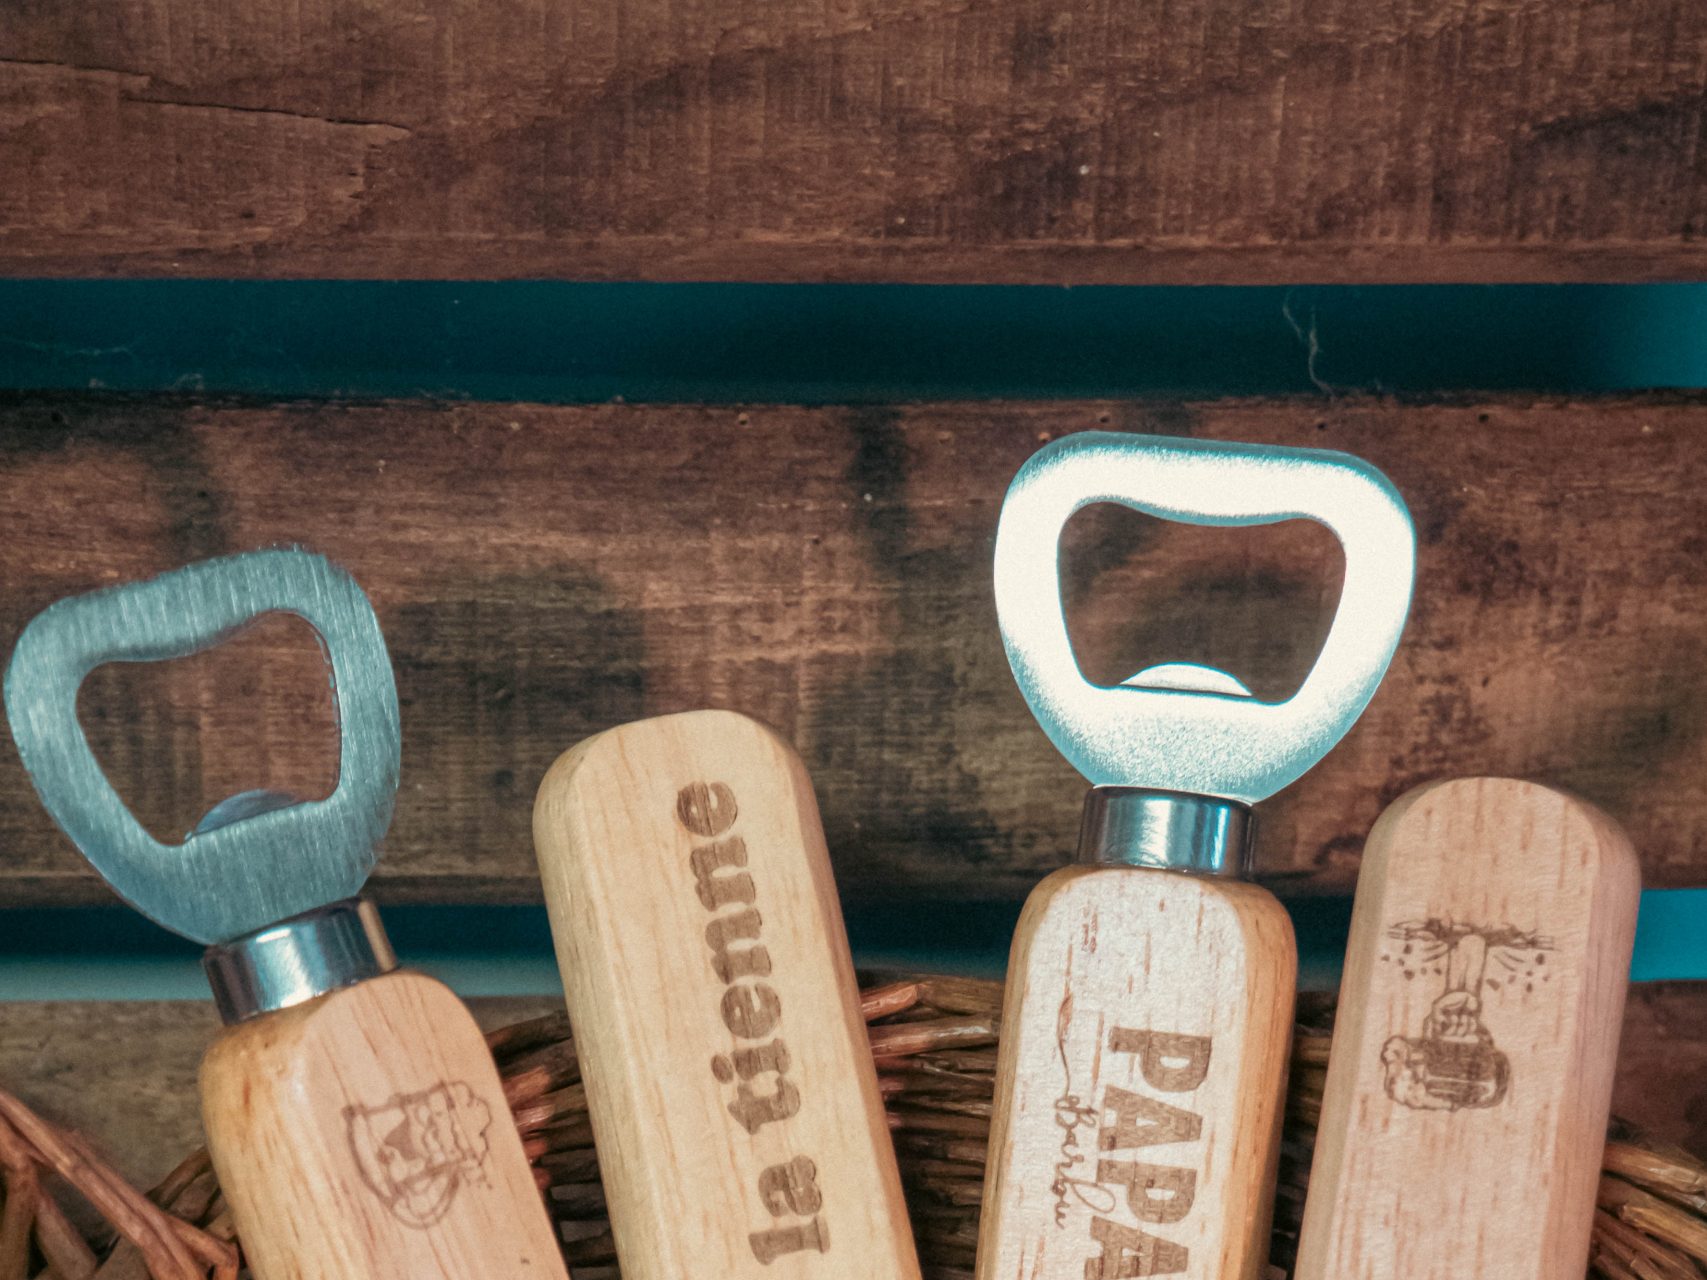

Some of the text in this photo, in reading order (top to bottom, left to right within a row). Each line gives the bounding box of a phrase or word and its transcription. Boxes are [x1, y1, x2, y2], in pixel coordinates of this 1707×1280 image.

[677, 779, 803, 1135] tienne
[748, 1153, 832, 1266] la
[1051, 996, 1117, 1230] Barbu
